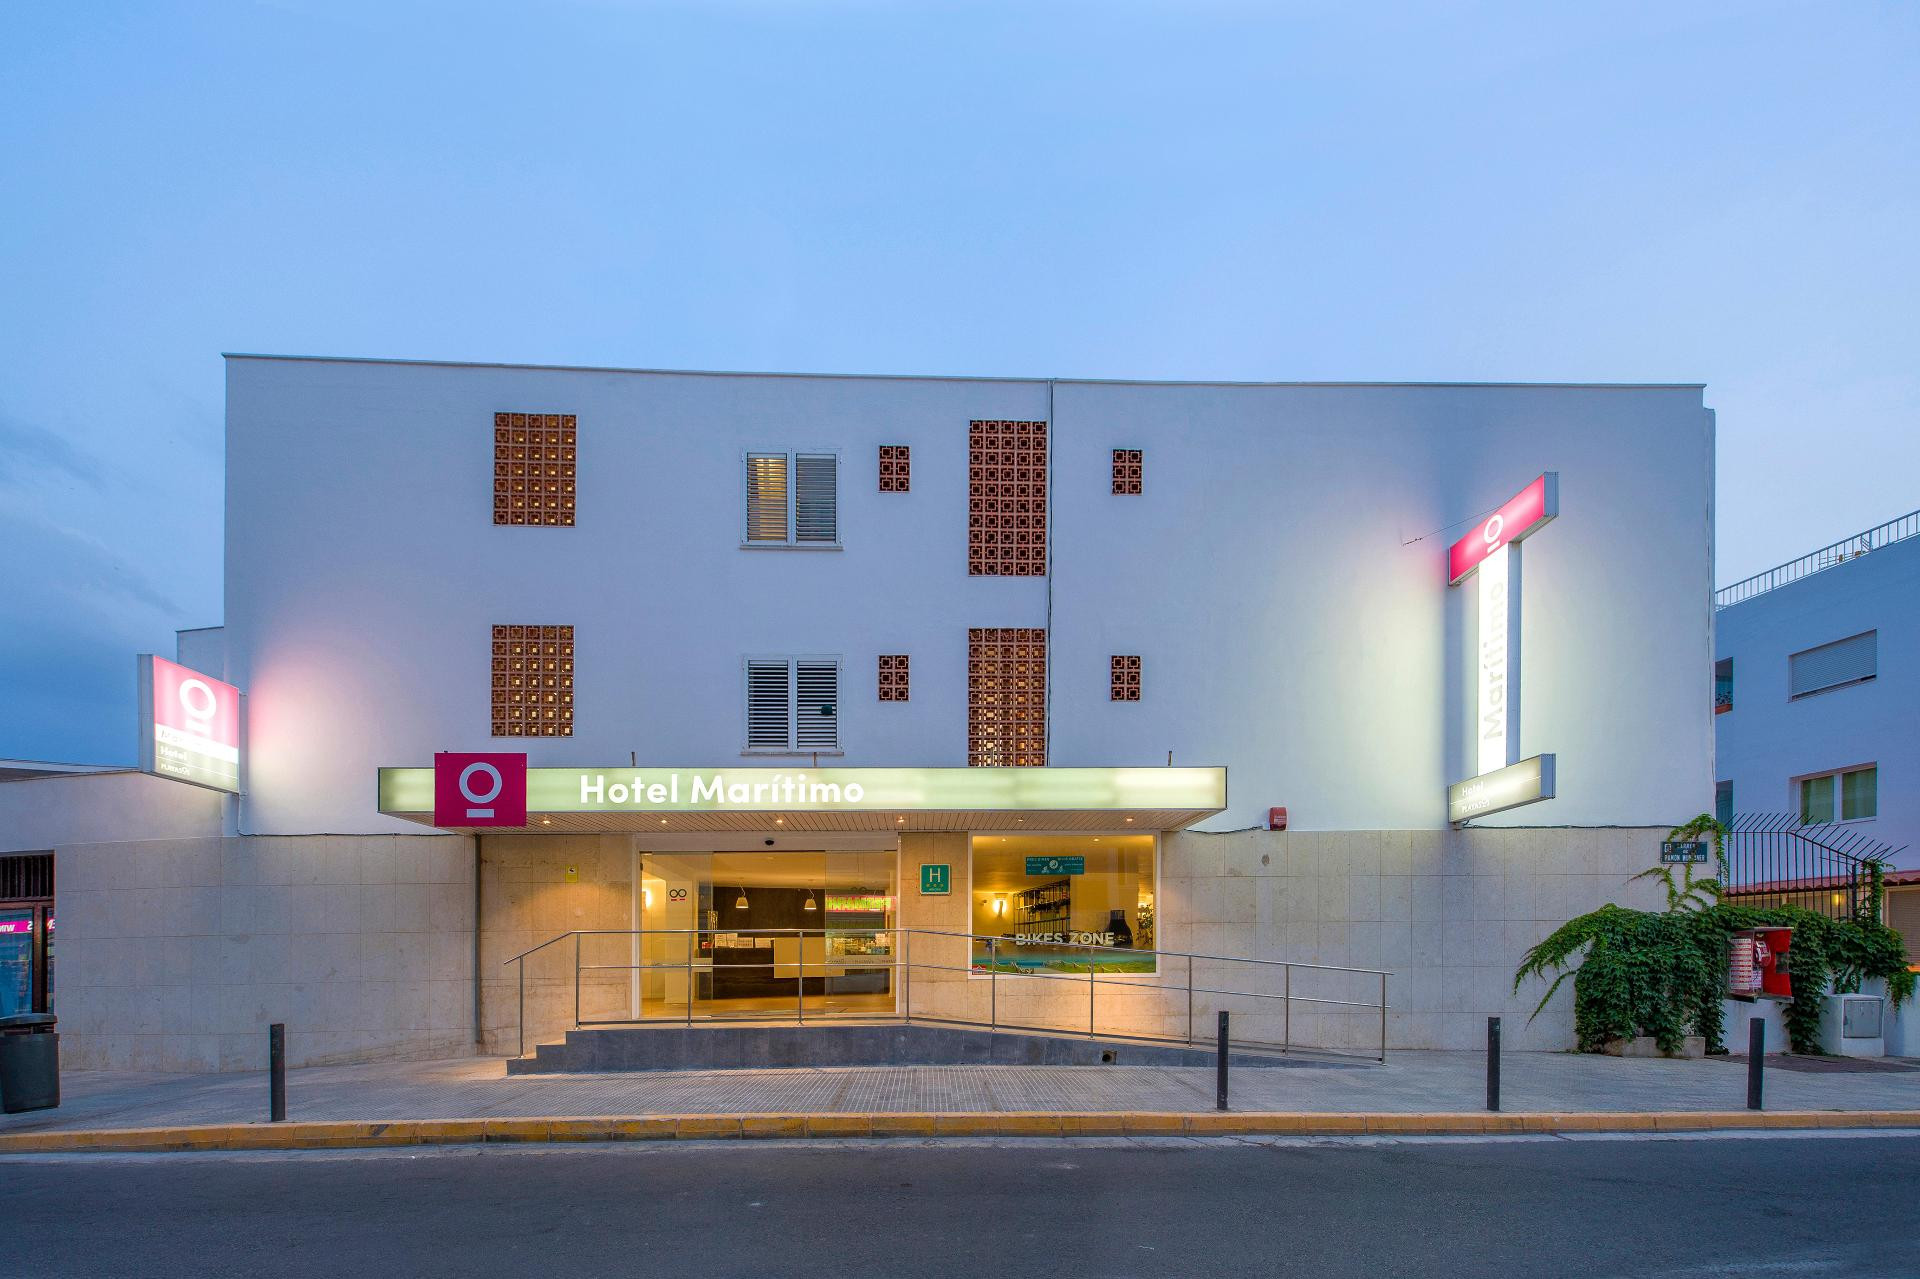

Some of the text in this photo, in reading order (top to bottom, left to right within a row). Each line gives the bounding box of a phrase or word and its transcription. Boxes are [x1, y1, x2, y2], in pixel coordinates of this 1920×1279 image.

[580, 773, 865, 804] Hotel Marítimo
[1462, 781, 1484, 796] Hotel
[929, 867, 941, 882] H
[1015, 931, 1115, 946] BIKES ZONE
